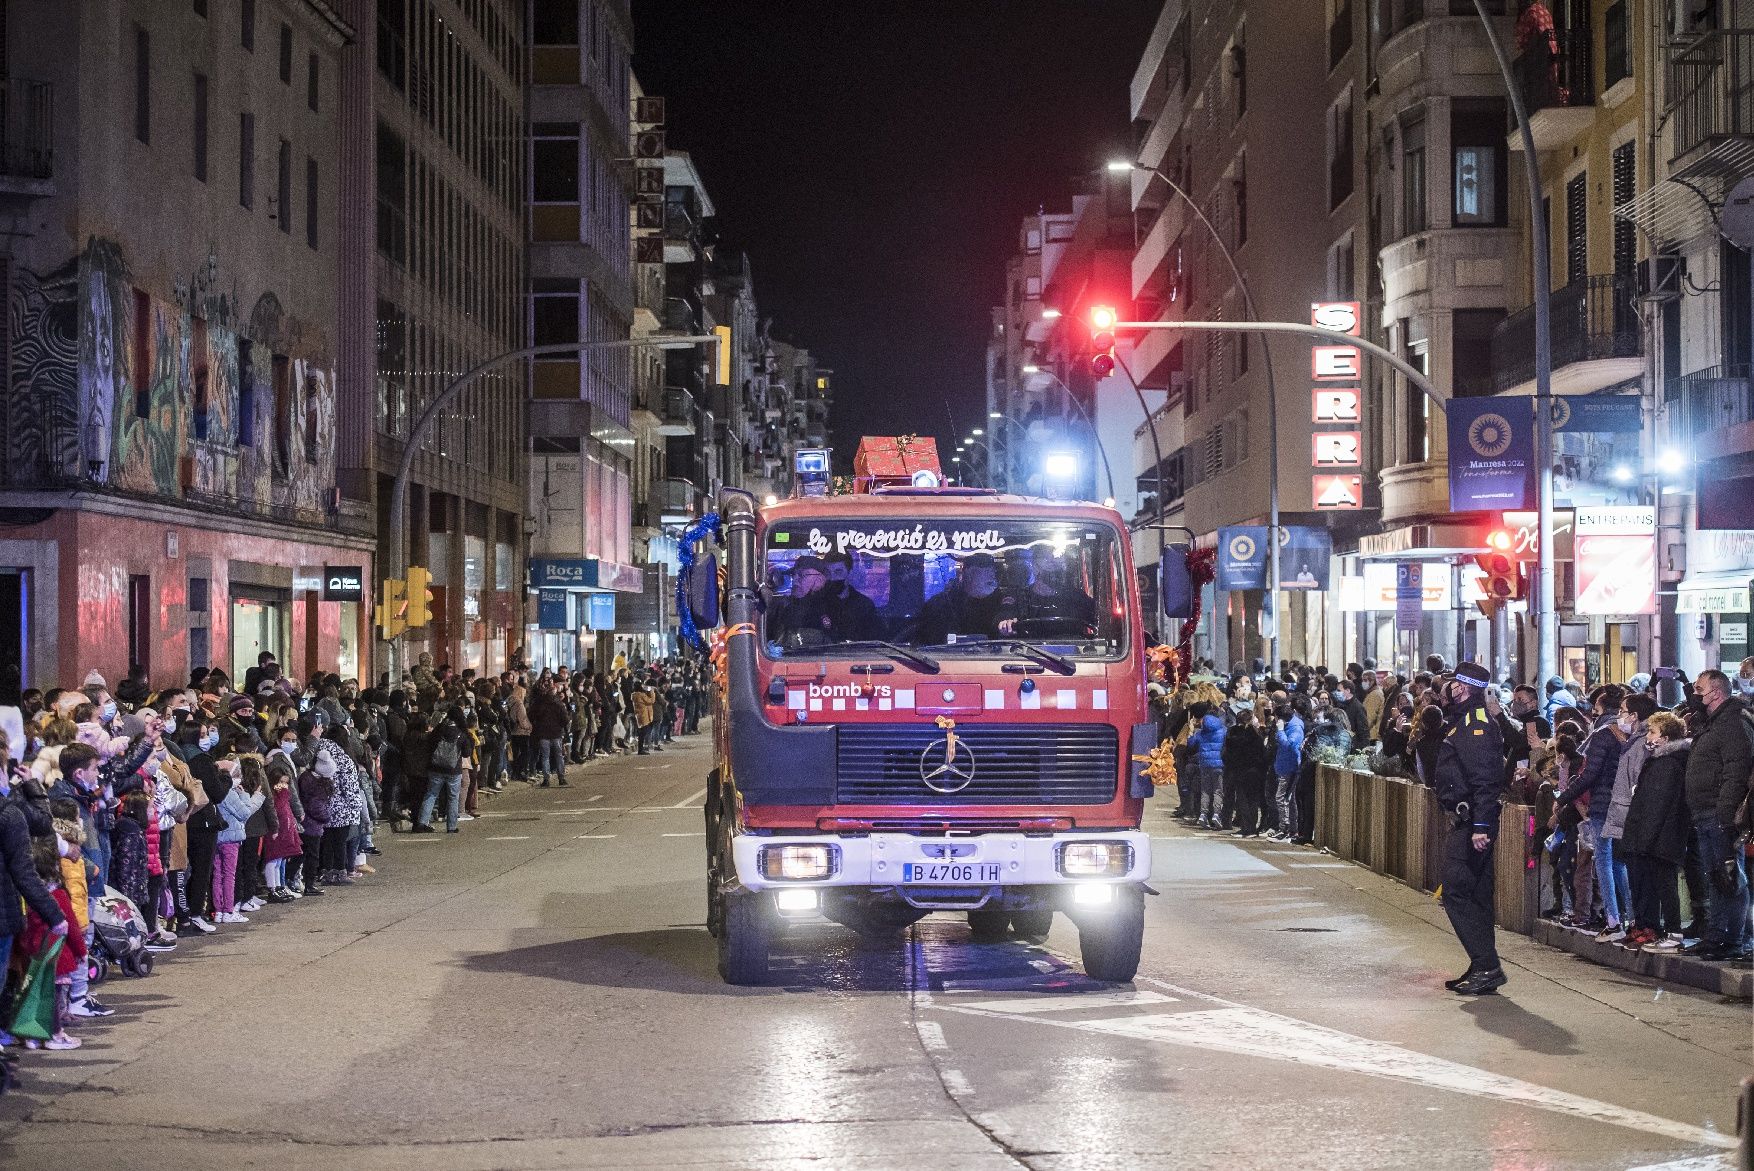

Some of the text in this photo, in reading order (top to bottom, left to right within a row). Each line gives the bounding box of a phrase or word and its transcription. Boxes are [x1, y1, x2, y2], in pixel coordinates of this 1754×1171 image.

[1315, 304, 1358, 507] SERRA
[1470, 460, 1506, 469] Manresa
[1579, 514, 1653, 525] ENTREPANS
[546, 565, 583, 576] Roca
[542, 591, 564, 599] Roca
[809, 682, 892, 697] bombrs
[914, 865, 924, 881] B
[929, 865, 973, 881] 4706
